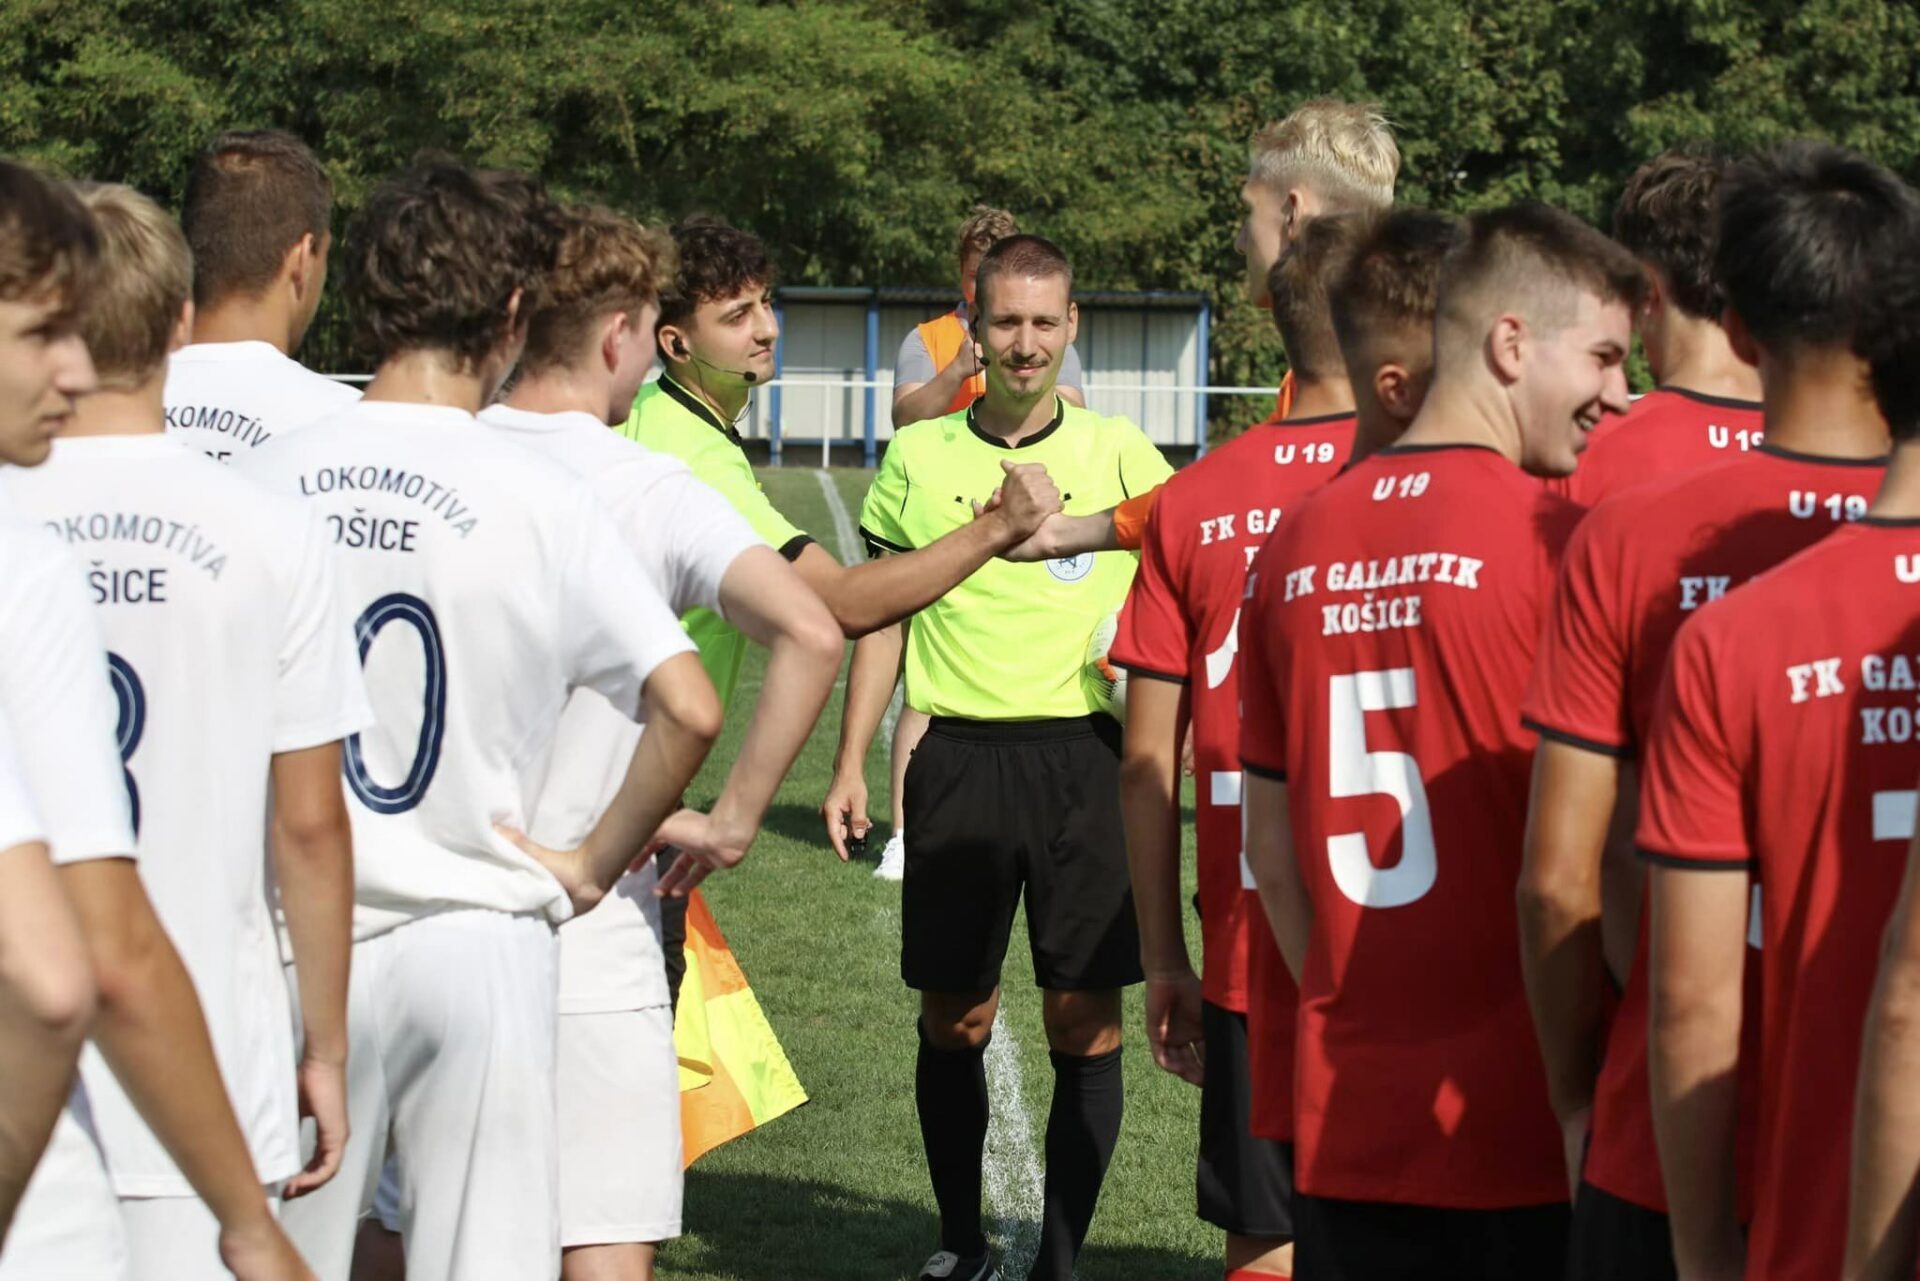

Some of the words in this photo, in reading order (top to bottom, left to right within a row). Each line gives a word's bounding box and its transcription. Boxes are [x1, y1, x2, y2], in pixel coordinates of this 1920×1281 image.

[165, 406, 271, 447] KOMOTÍV
[1708, 425, 1729, 448] U
[1274, 444, 1295, 464] U
[1302, 443, 1335, 463] 19
[300, 466, 478, 539] LOKOMOTÍVA
[1372, 476, 1396, 501] U
[1399, 471, 1431, 498] 19
[1789, 490, 1816, 519] U
[1824, 493, 1868, 521] 19
[44, 513, 228, 581] KOMOTÍVA
[327, 507, 419, 552] OŠICE
[1200, 514, 1236, 545] FK
[88, 560, 167, 604] ŠICE
[1284, 565, 1317, 602] FK
[1326, 552, 1484, 589] GALAKTIK
[1894, 554, 1920, 583] U
[1321, 592, 1421, 636] KOŠICE
[1786, 657, 1845, 704] FK
[1327, 667, 1438, 909] 5
